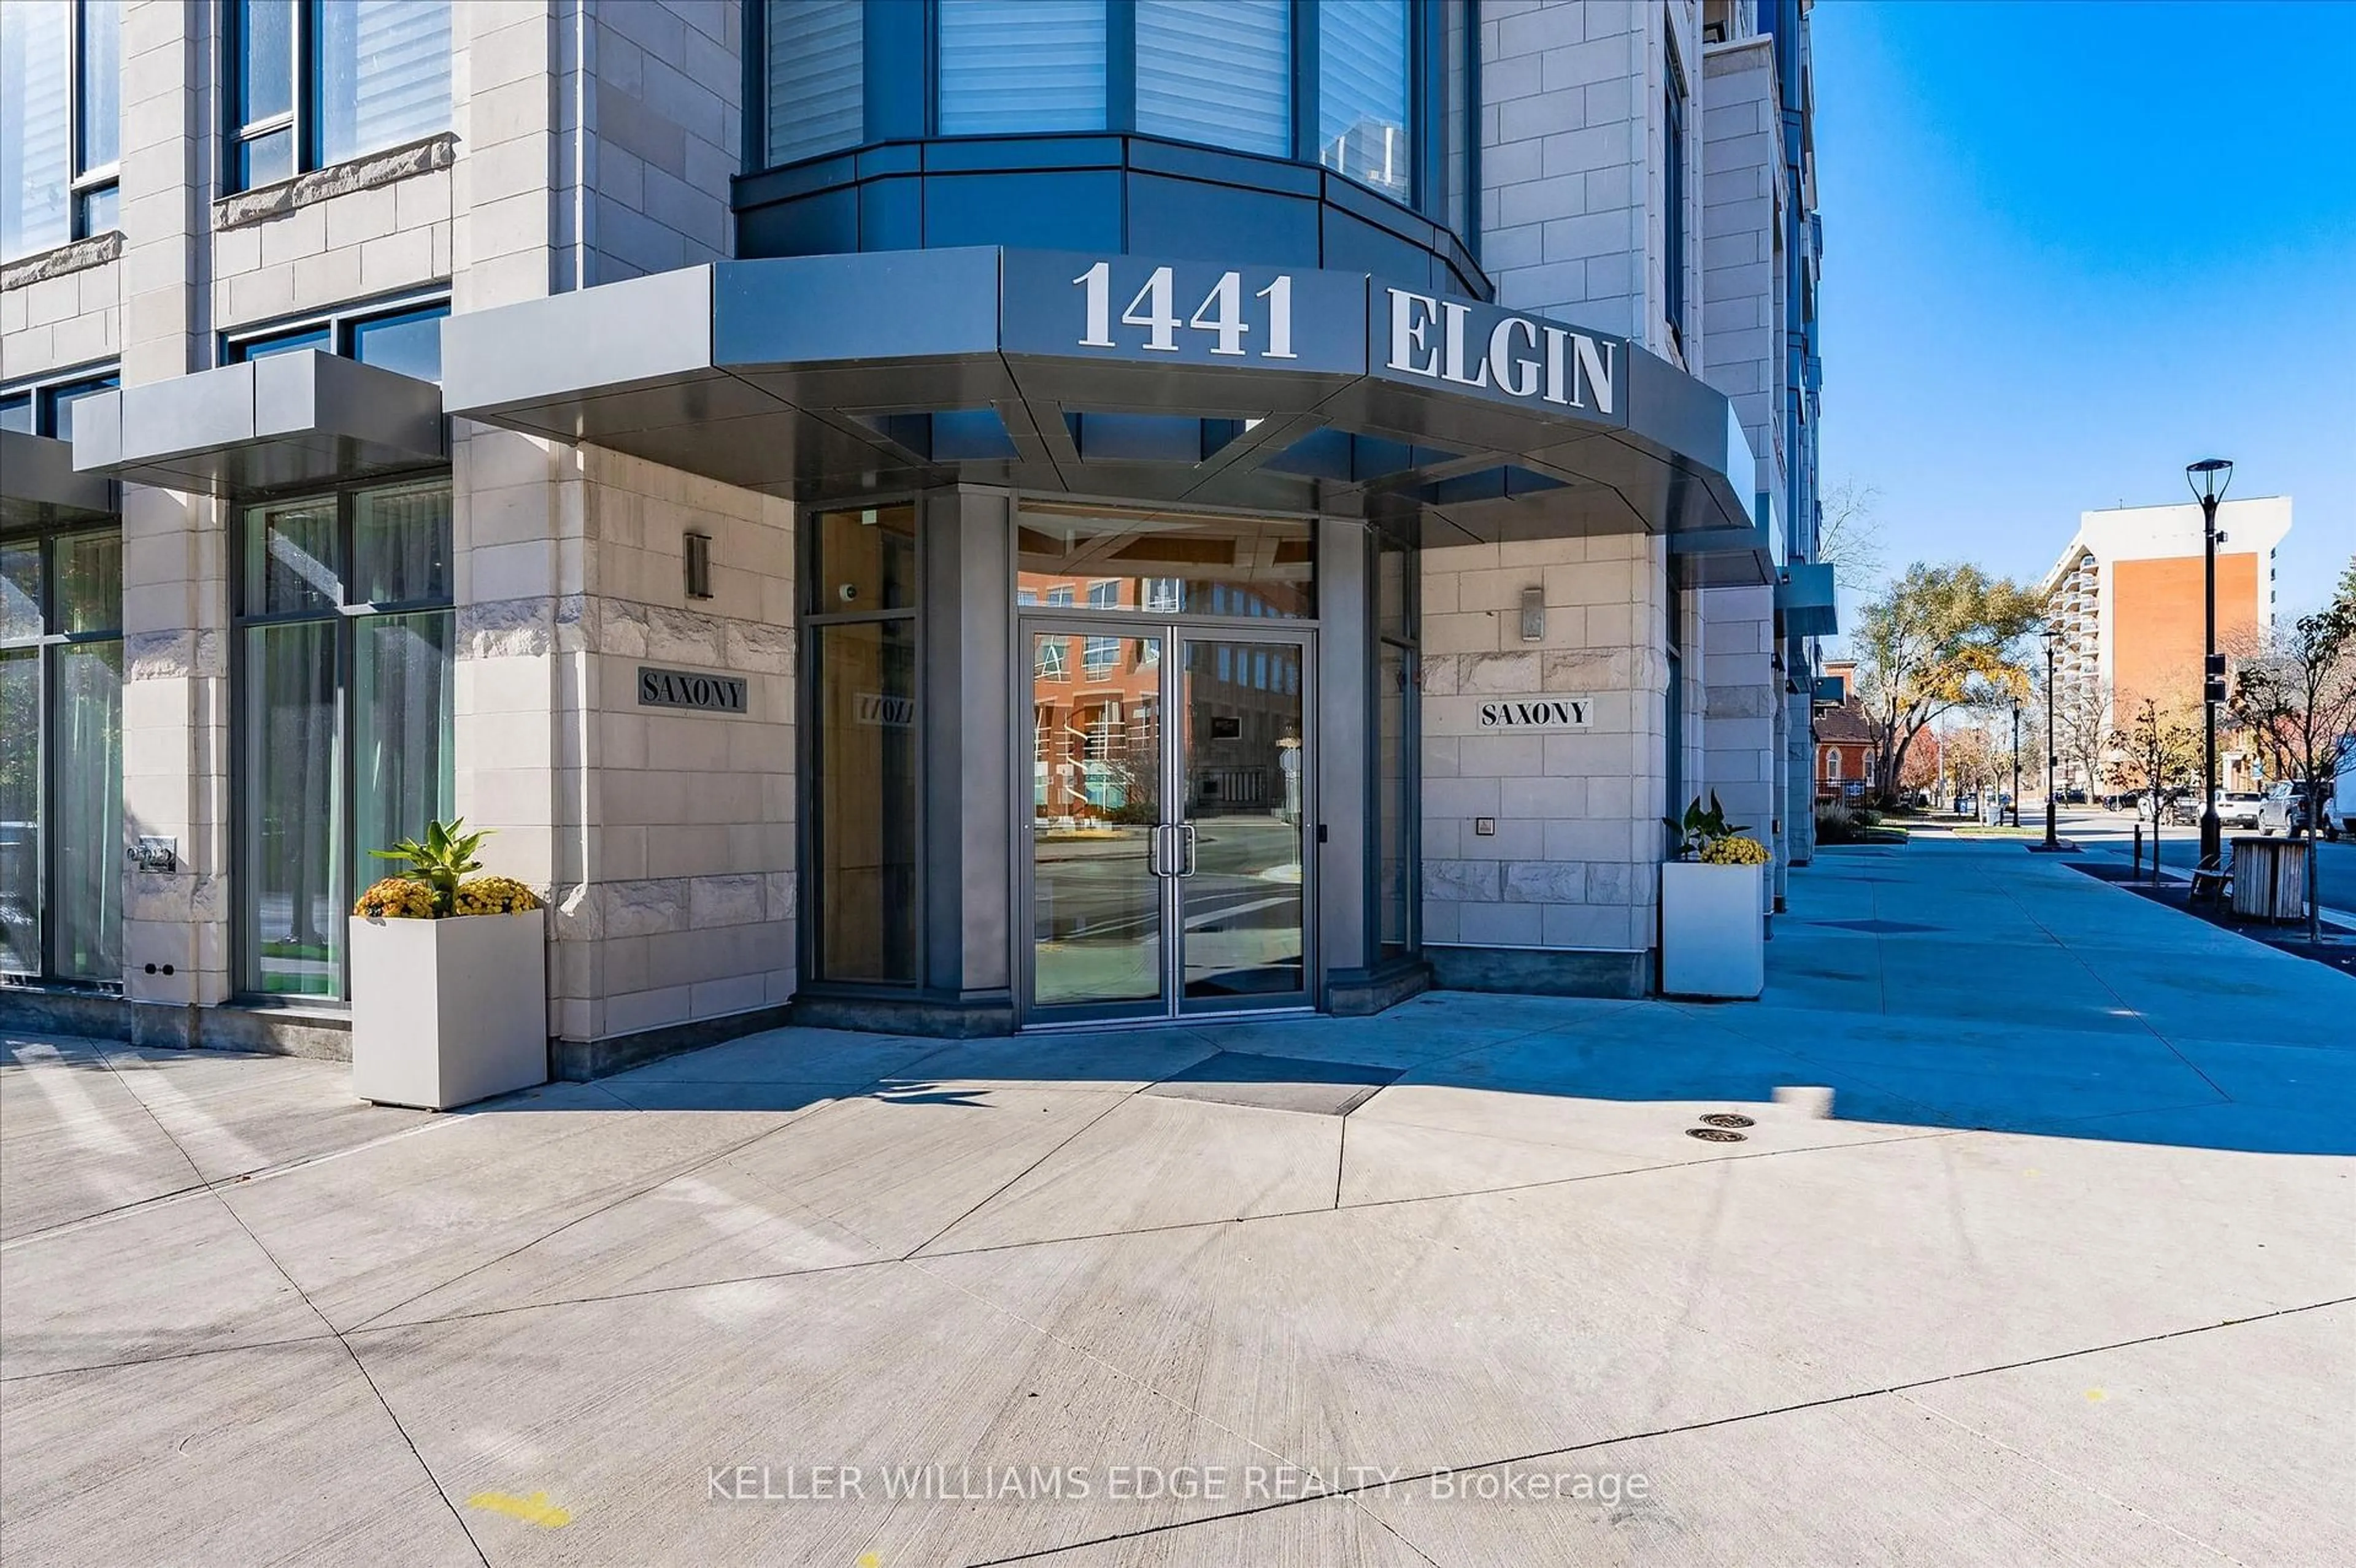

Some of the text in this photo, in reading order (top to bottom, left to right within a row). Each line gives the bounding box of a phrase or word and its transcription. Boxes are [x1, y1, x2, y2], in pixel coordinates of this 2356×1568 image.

[1072, 262, 1617, 413] 1441 ELGIN
[644, 672, 742, 709] SAXONY
[1482, 702, 1588, 726] SAXONY
